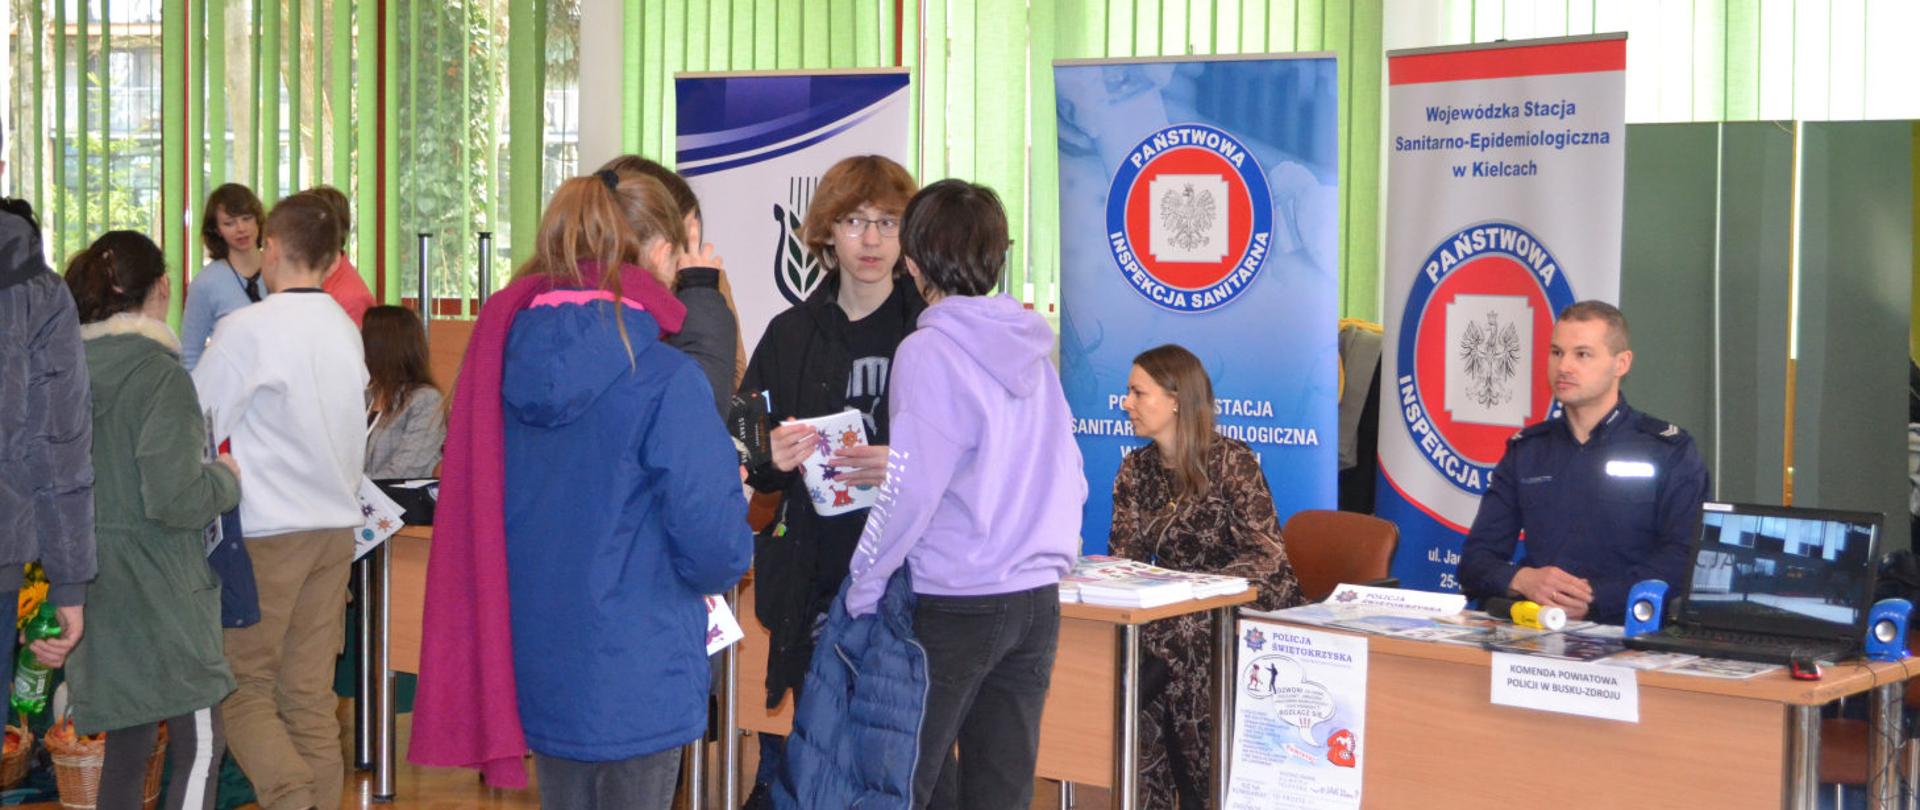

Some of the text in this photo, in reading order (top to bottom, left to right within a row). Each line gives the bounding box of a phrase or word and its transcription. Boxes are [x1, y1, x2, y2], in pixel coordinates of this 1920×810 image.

[1426, 100, 1576, 125] Wojewódzka Stacja
[1130, 128, 1247, 169] PAŃSTWOWA
[1395, 128, 1611, 152] Sanitarno-Epidemiologiczna
[1452, 160, 1538, 178] w Kielcach
[1425, 227, 1556, 287] PAŃSTWOWA
[1110, 231, 1269, 308] INSPEKCJA SANITARNA
[1213, 398, 1274, 418] STACJA
[1071, 417, 1136, 437] SANITAR
[1399, 374, 1481, 490] INSPEKCJA
[1272, 632, 1312, 645] POLICJA
[1510, 664, 1618, 686] KOMENDA POWIATOWA
[1507, 677, 1621, 701] POLICJI W BUSKU-ZDROJU
